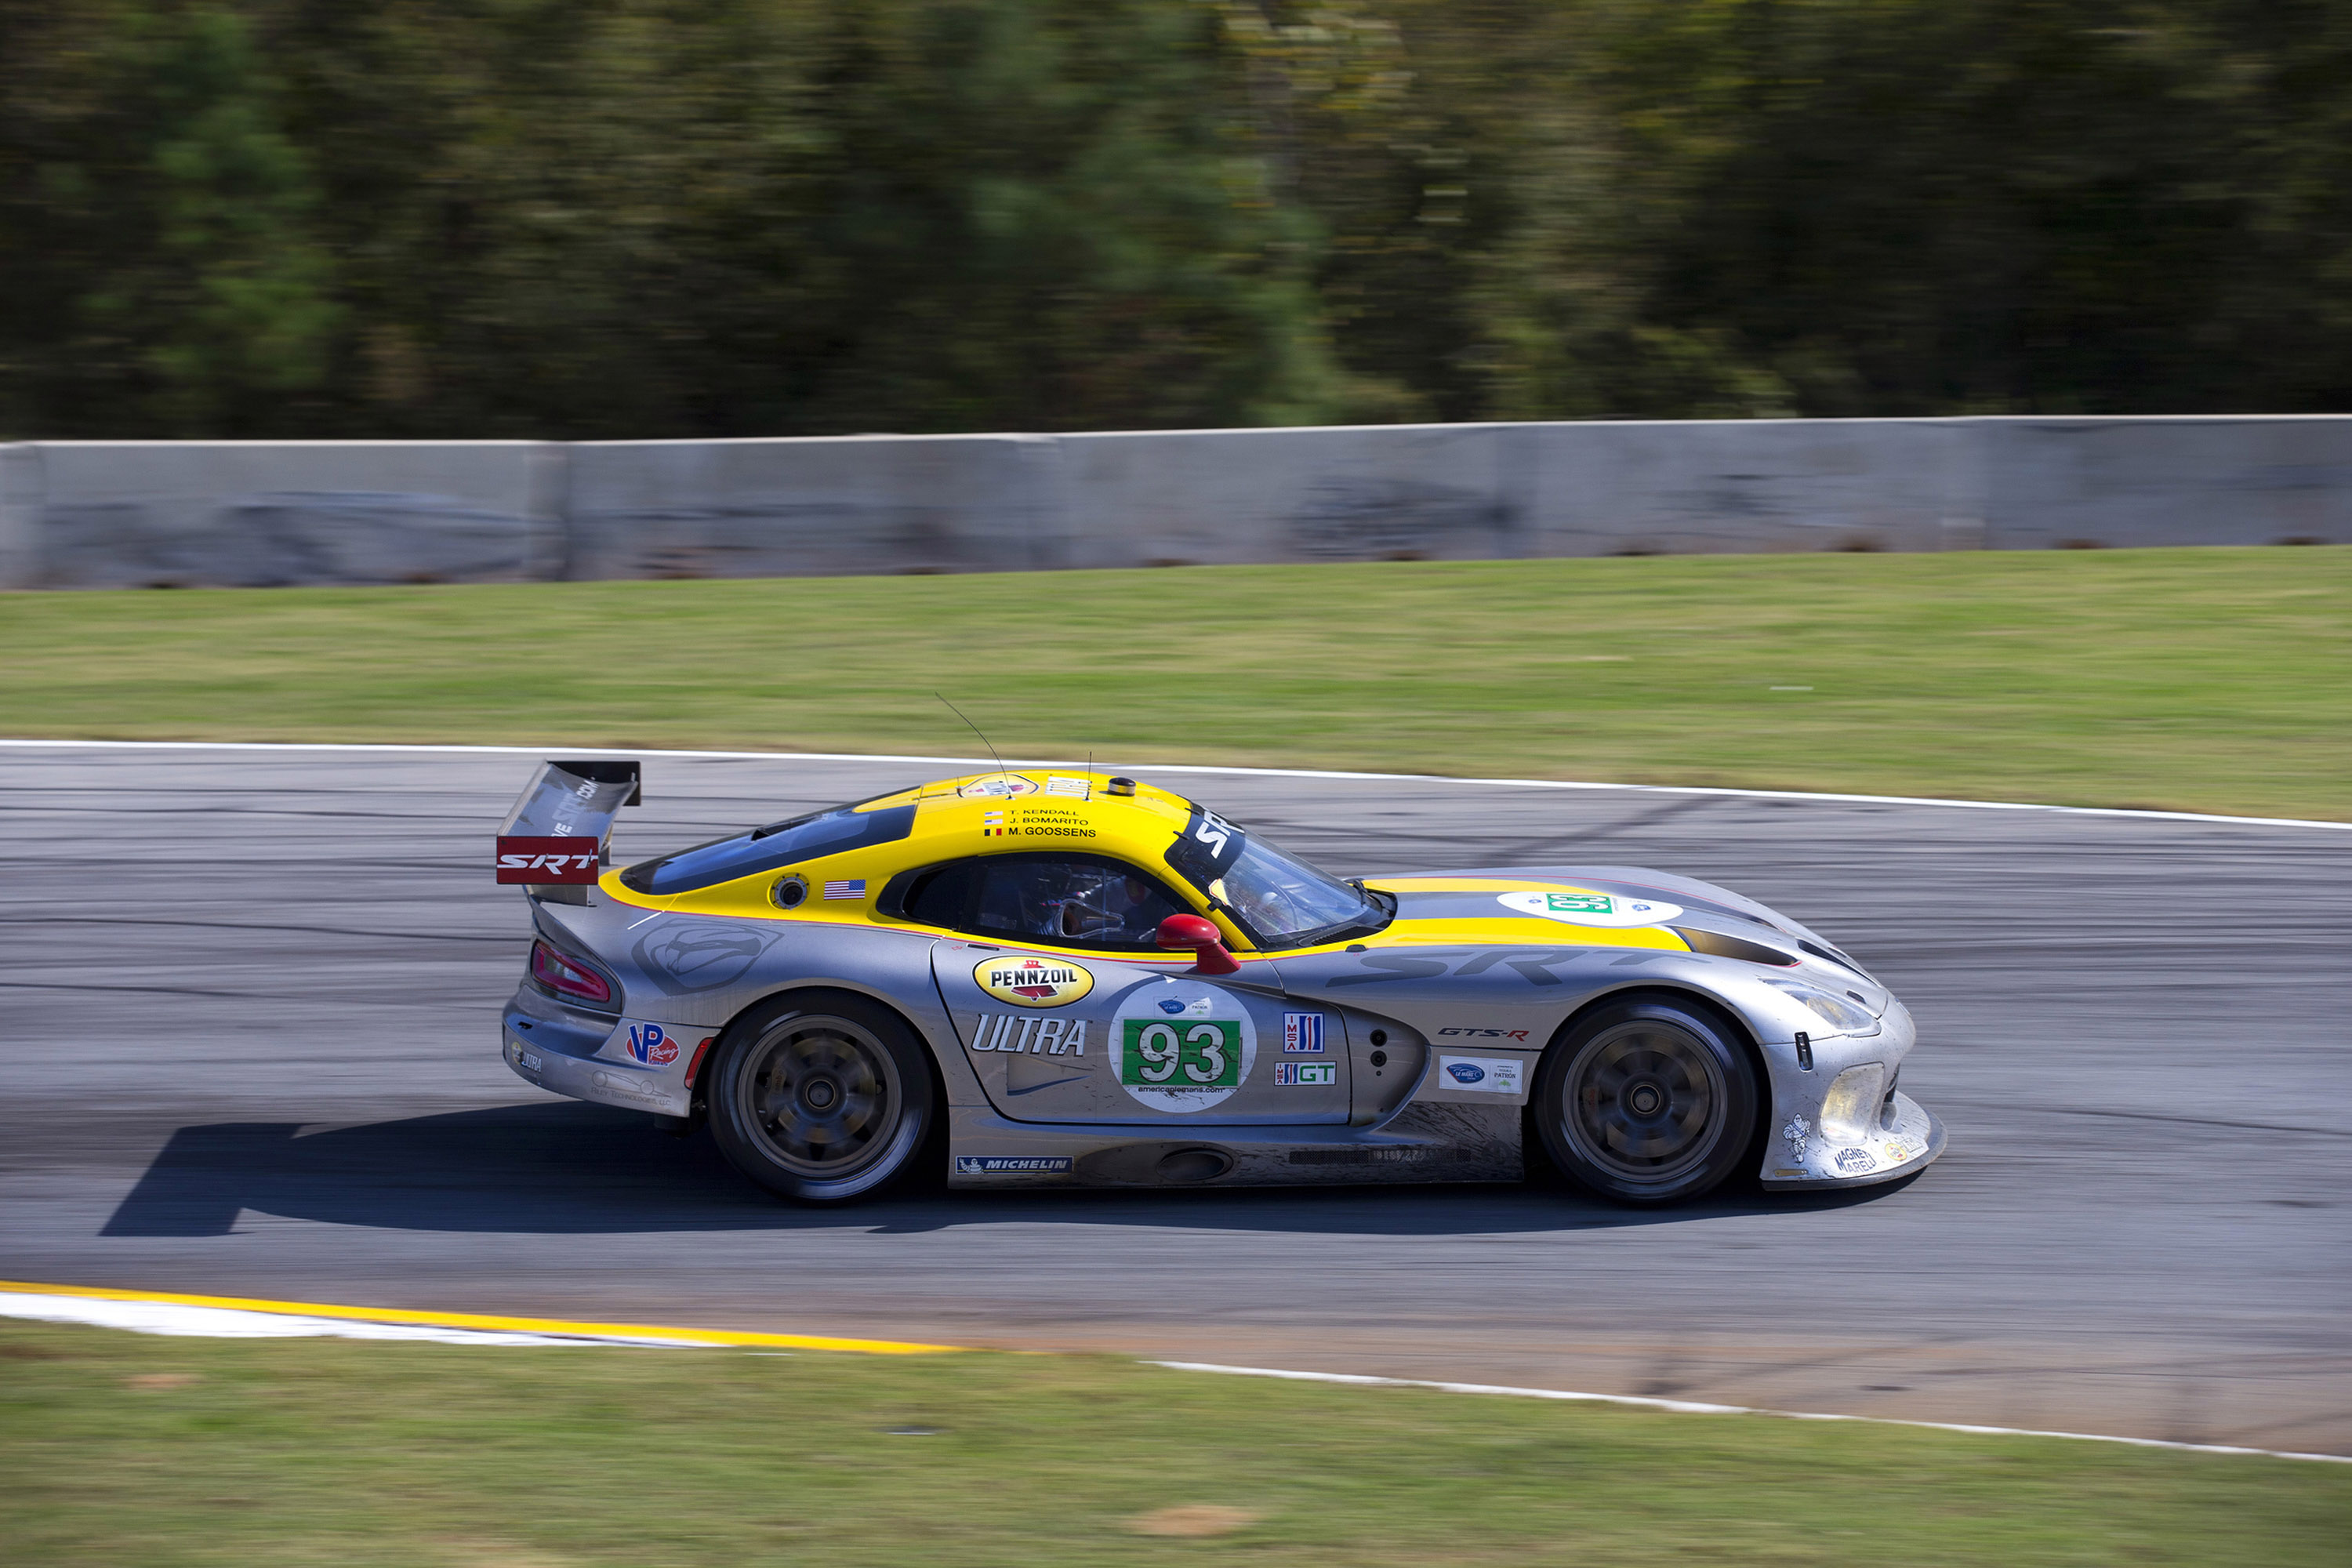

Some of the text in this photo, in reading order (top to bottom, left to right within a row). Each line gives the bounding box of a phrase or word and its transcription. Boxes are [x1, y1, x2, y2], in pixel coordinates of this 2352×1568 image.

[1022, 817, 1089, 826] BOMARITO
[1008, 826, 1097, 838] M. GOOSSENS
[1196, 808, 1245, 859] SR
[497, 853, 598, 875] SRT
[1549, 895, 1610, 911] 93
[990, 968, 1078, 988] PENNZOIL
[1326, 949, 1712, 987] SRT
[971, 1013, 1088, 1057] ULTRA
[1287, 1015, 1298, 1051] IMSA
[1438, 1027, 1530, 1042] GTS-R
[629, 1023, 664, 1064] VP
[650, 1047, 679, 1060] Racing
[1138, 1022, 1227, 1083] 93
[1299, 1065, 1335, 1082] GT
[985, 1160, 1069, 1169] MICHELIN
